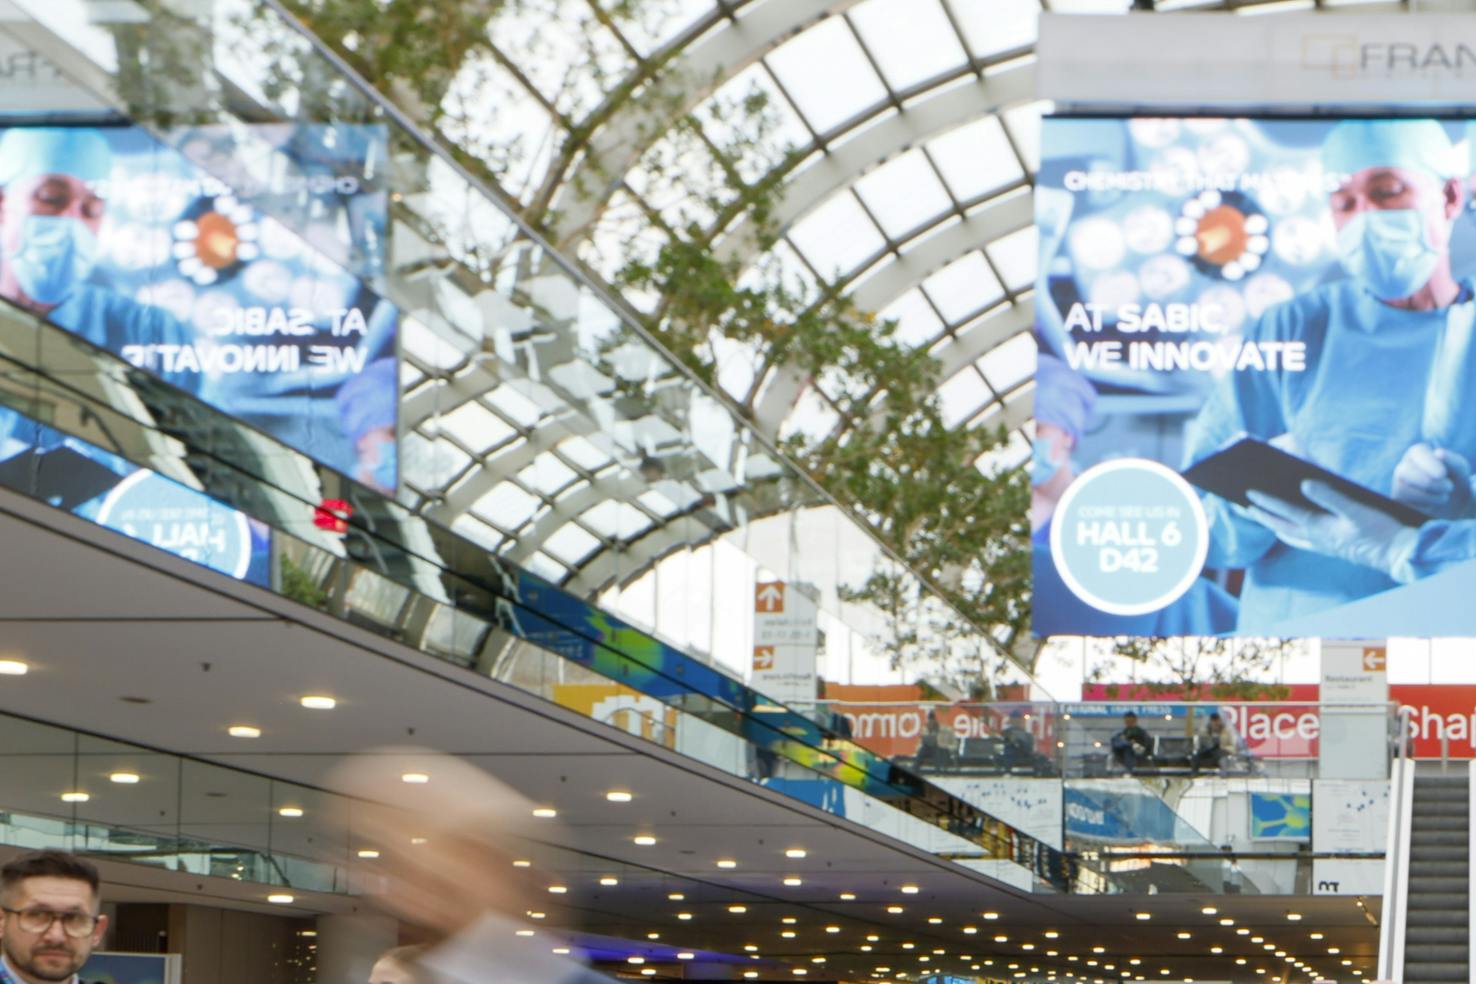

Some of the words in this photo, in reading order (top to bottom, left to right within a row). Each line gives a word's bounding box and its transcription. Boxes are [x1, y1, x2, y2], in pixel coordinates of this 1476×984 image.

[1063, 302, 1105, 332] AT
[1063, 341, 1122, 371] WE
[1129, 341, 1307, 371] INNOVATE
[1076, 519, 1156, 547] HALL
[1161, 520, 1182, 547] 6
[1099, 547, 1159, 573] D42
